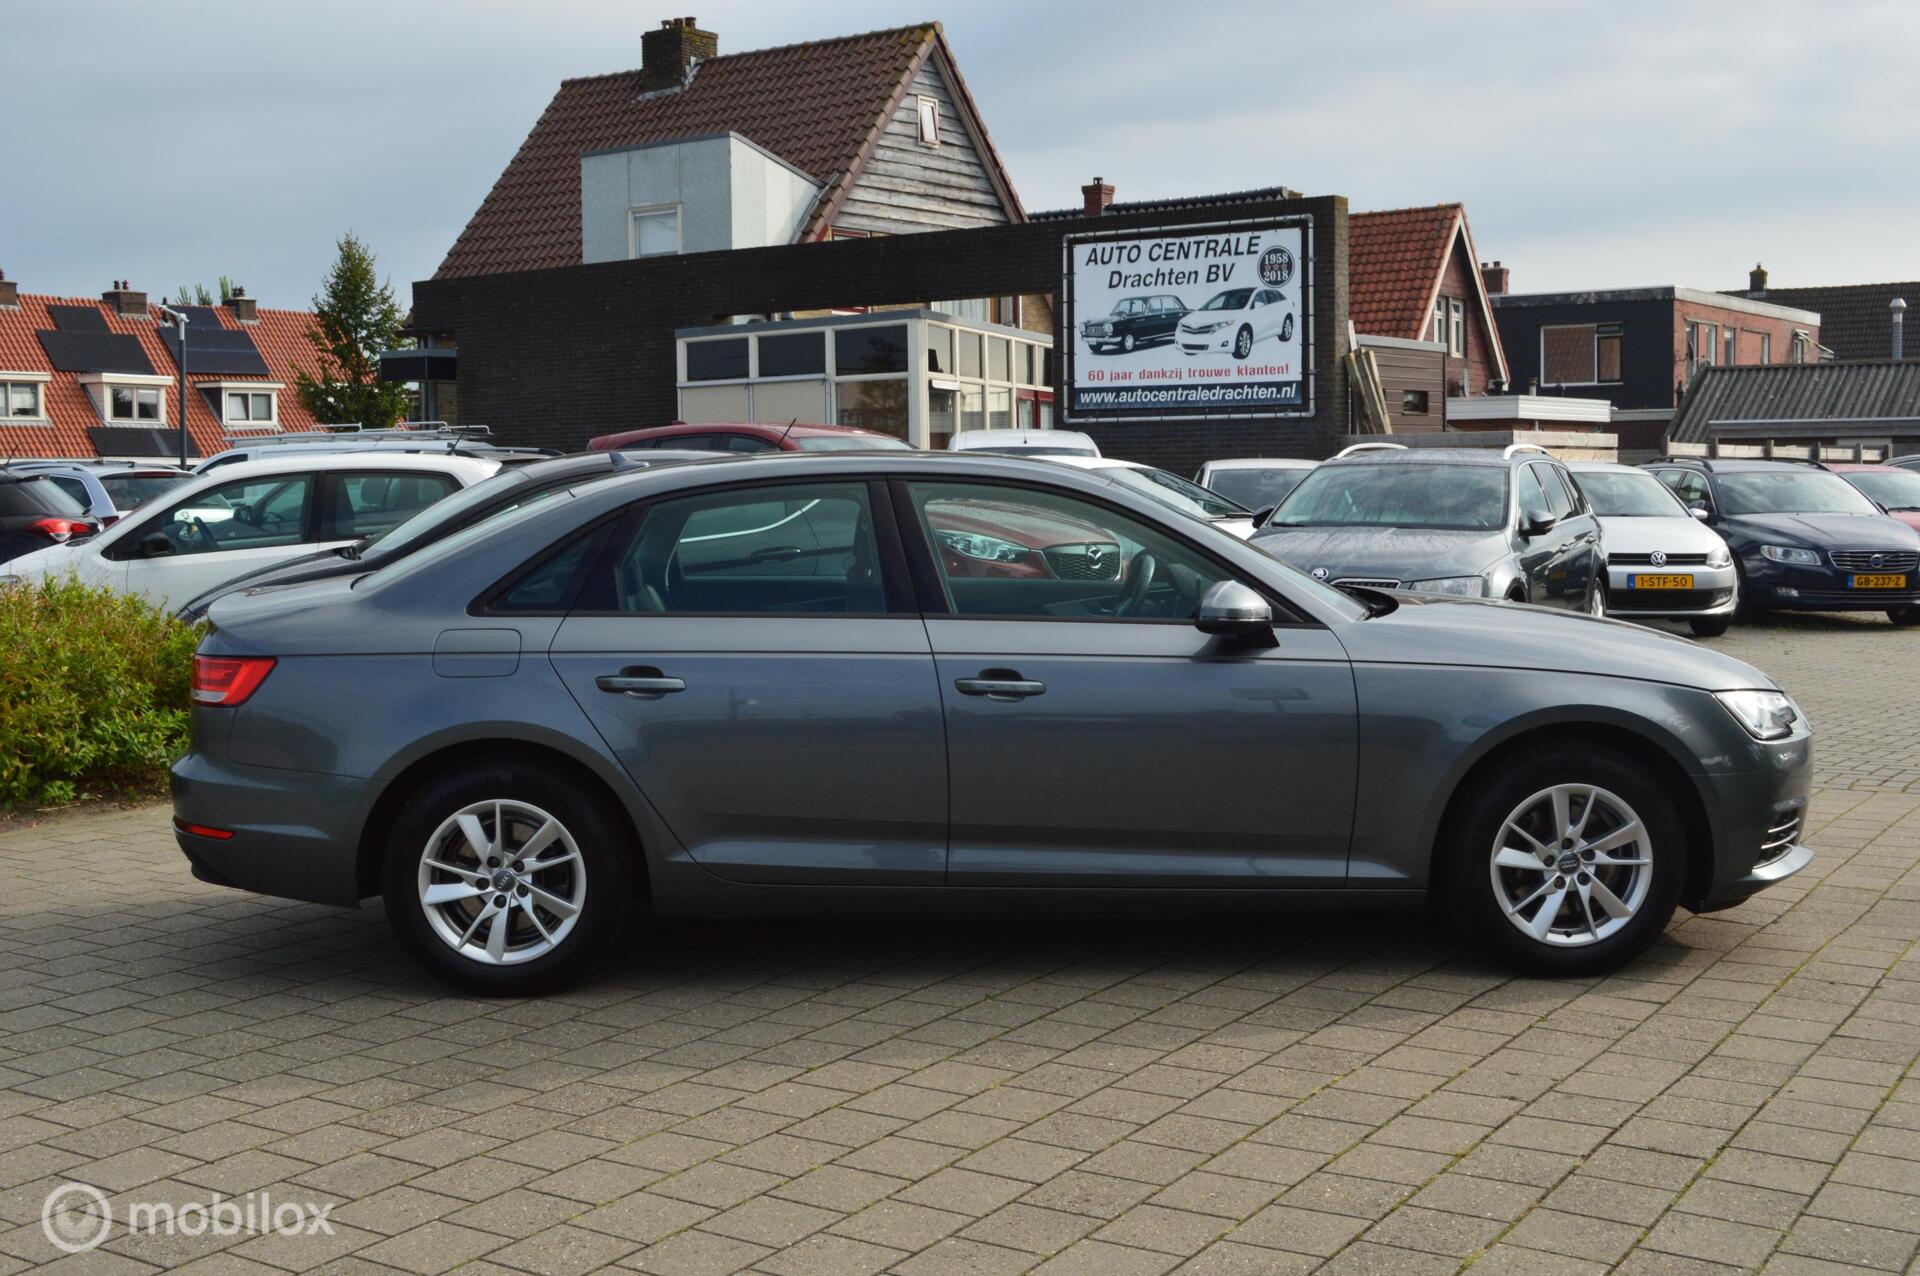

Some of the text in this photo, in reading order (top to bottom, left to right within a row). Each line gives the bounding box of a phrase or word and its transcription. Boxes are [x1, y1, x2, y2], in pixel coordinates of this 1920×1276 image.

[1085, 235, 1261, 266] AUTO CENTRALE
[1264, 253, 1289, 265] 1958
[1108, 263, 1235, 289] Drachten BV
[1263, 271, 1289, 282] 2018
[1087, 363, 1289, 382] 60 jaar dankzij trouwe klanten!
[1080, 383, 1296, 404] www.autocentraledrachten.nl
[1640, 577, 1687, 587] 1-STF-50
[1856, 577, 1901, 586] GB-237-Z
